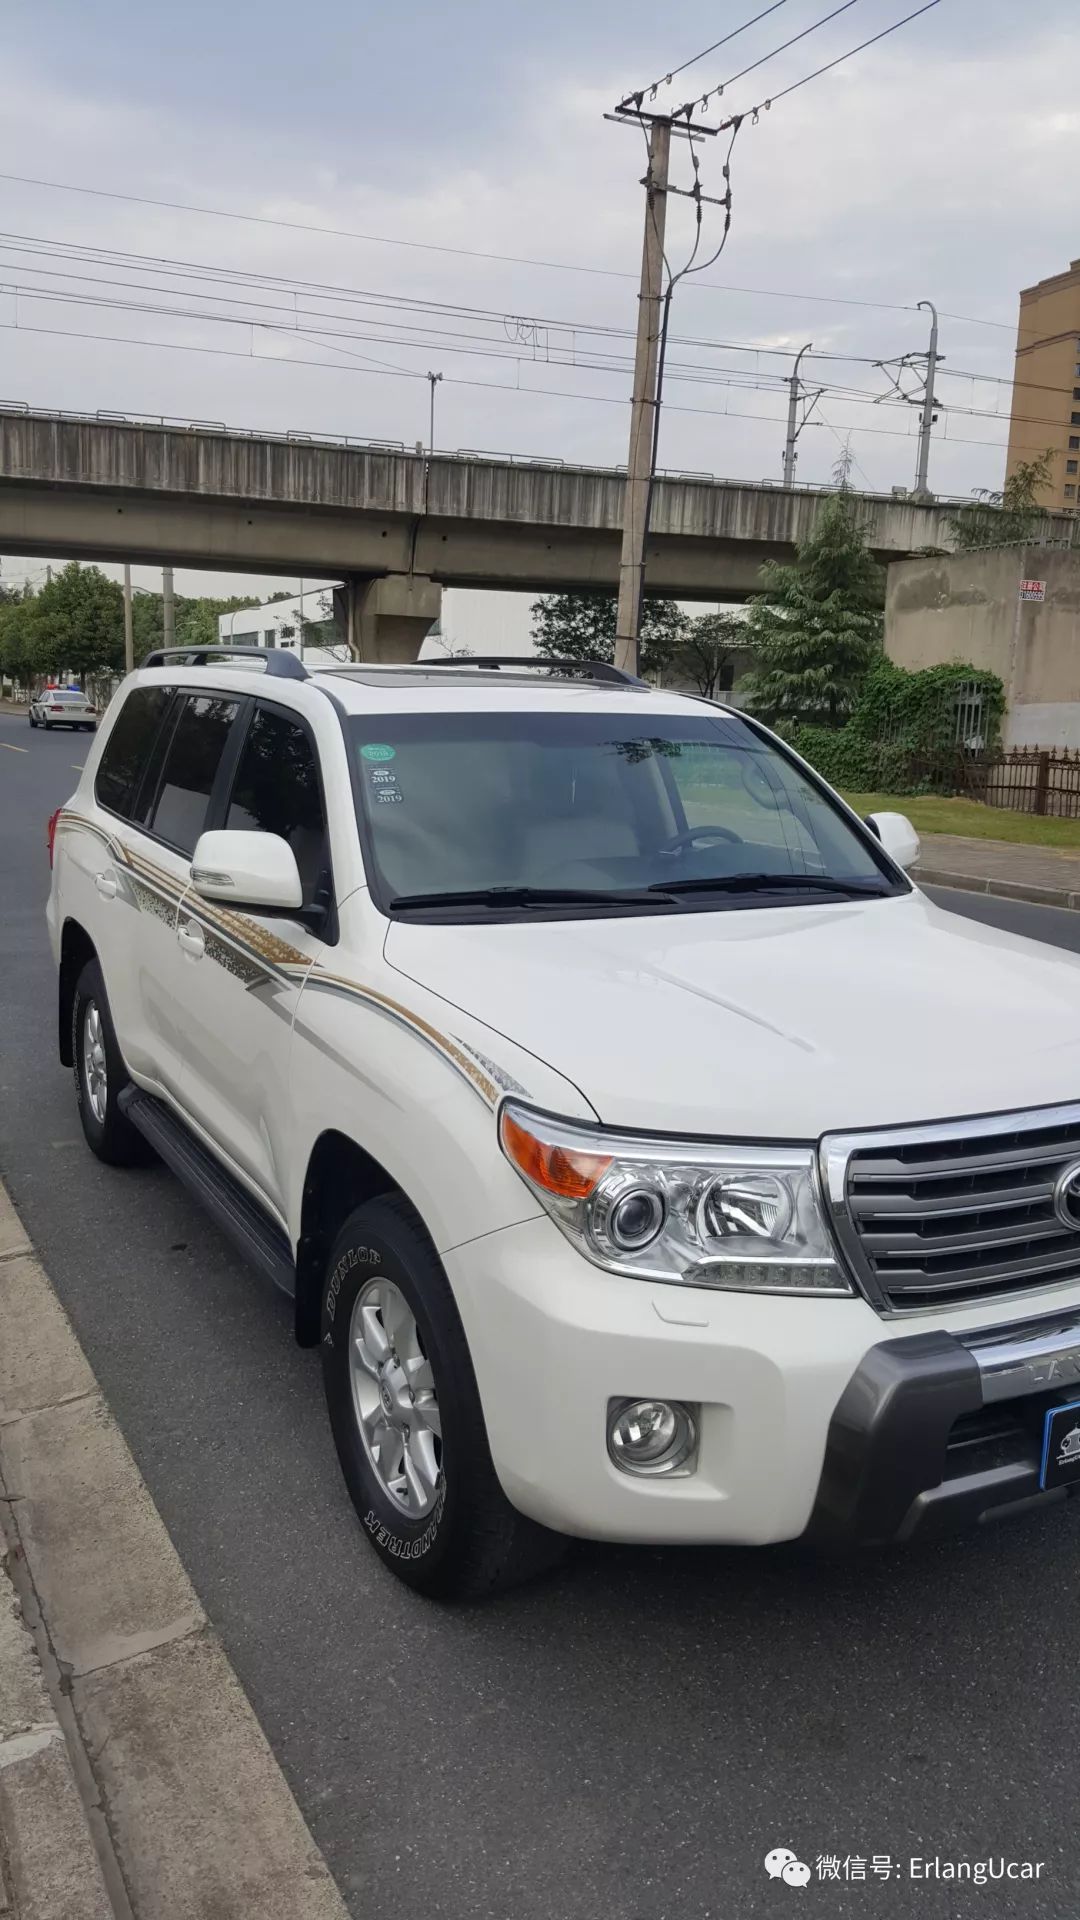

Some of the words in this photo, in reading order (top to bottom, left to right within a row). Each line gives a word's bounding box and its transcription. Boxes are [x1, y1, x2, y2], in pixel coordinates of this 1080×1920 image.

[371, 775, 396, 783] 2019
[377, 794, 403, 803] 2019
[327, 1246, 381, 1321] DUNLOP
